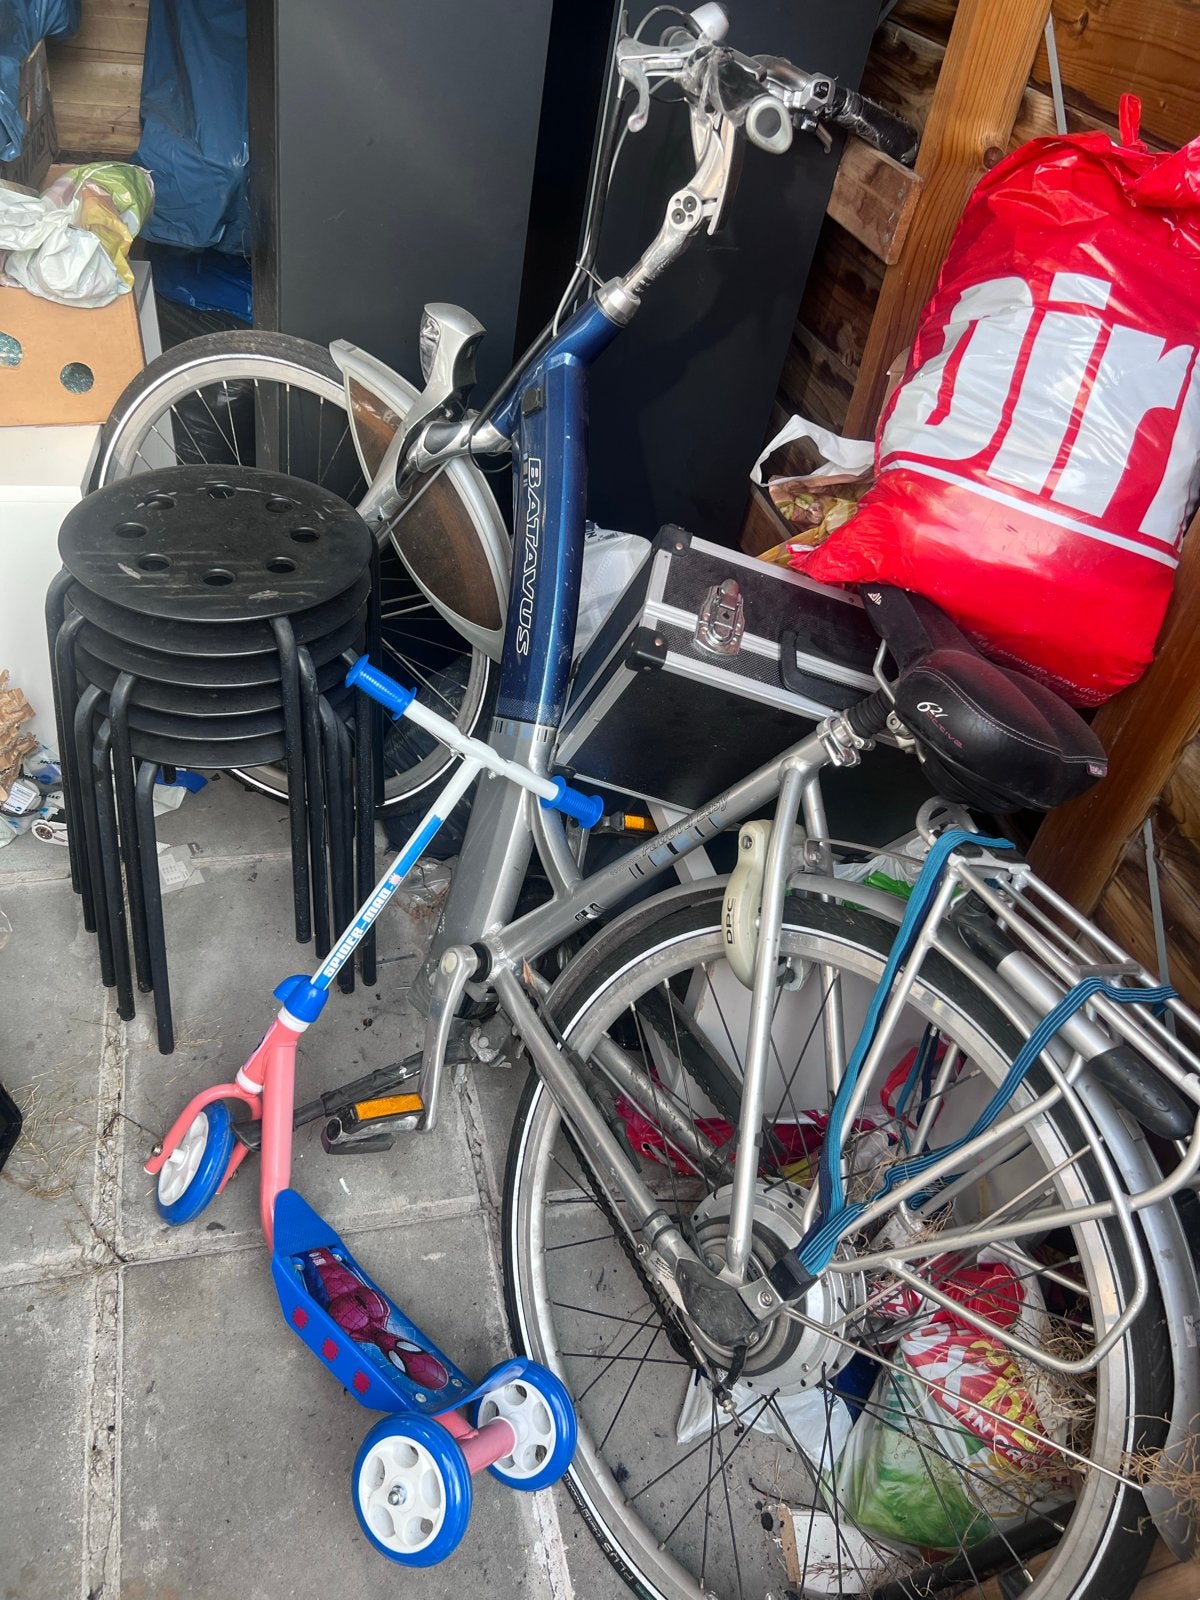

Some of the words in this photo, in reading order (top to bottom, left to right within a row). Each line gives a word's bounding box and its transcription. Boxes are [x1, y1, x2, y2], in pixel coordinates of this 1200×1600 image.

[516, 457, 541, 656] BATAVUS
[322, 886, 393, 979] SPIDER-MAN
[726, 897, 735, 945] DPC
[601, 1541, 634, 1582] PLUS
